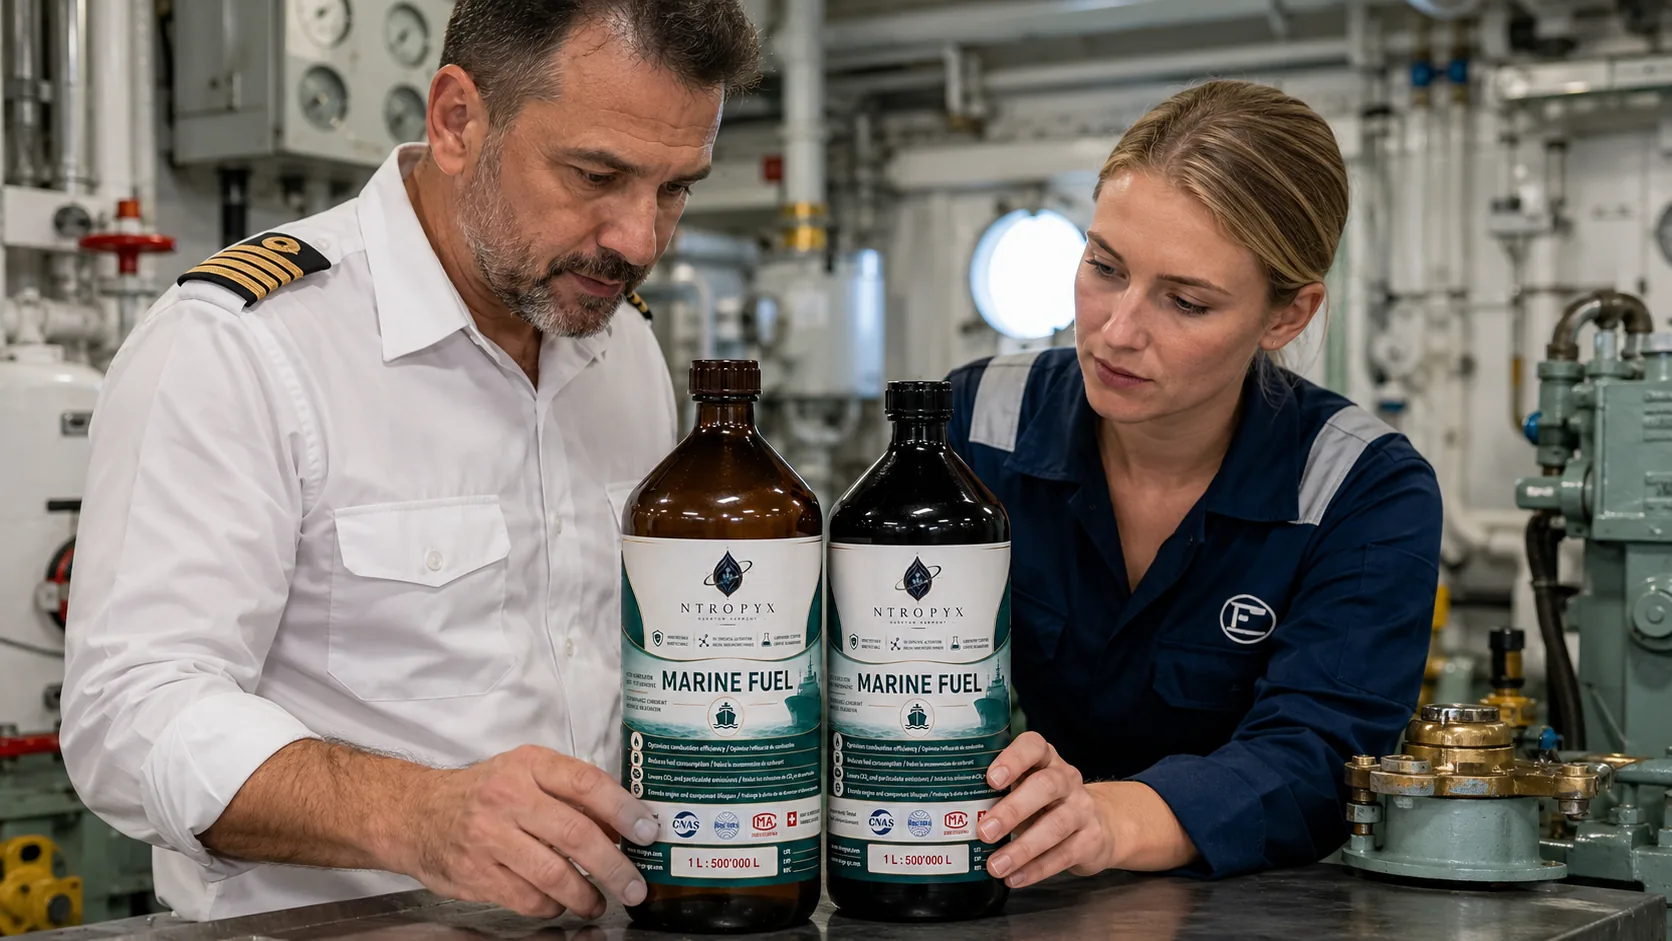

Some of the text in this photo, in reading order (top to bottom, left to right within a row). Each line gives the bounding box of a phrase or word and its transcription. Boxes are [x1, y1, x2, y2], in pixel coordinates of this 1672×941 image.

[681, 602, 775, 614] NTROPYX
[873, 607, 964, 618] NTROPYX
[662, 670, 742, 693] MARINE
[748, 669, 793, 692] FUEL
[857, 672, 932, 694] MARINE
[938, 672, 982, 694] FUEL
[700, 744, 725, 753] efficiency
[672, 820, 700, 830] CNAS
[868, 818, 894, 828] CNAS
[688, 857, 760, 869] 1 L : 500'000 L
[883, 854, 952, 865] 1 L : 500'000 L
